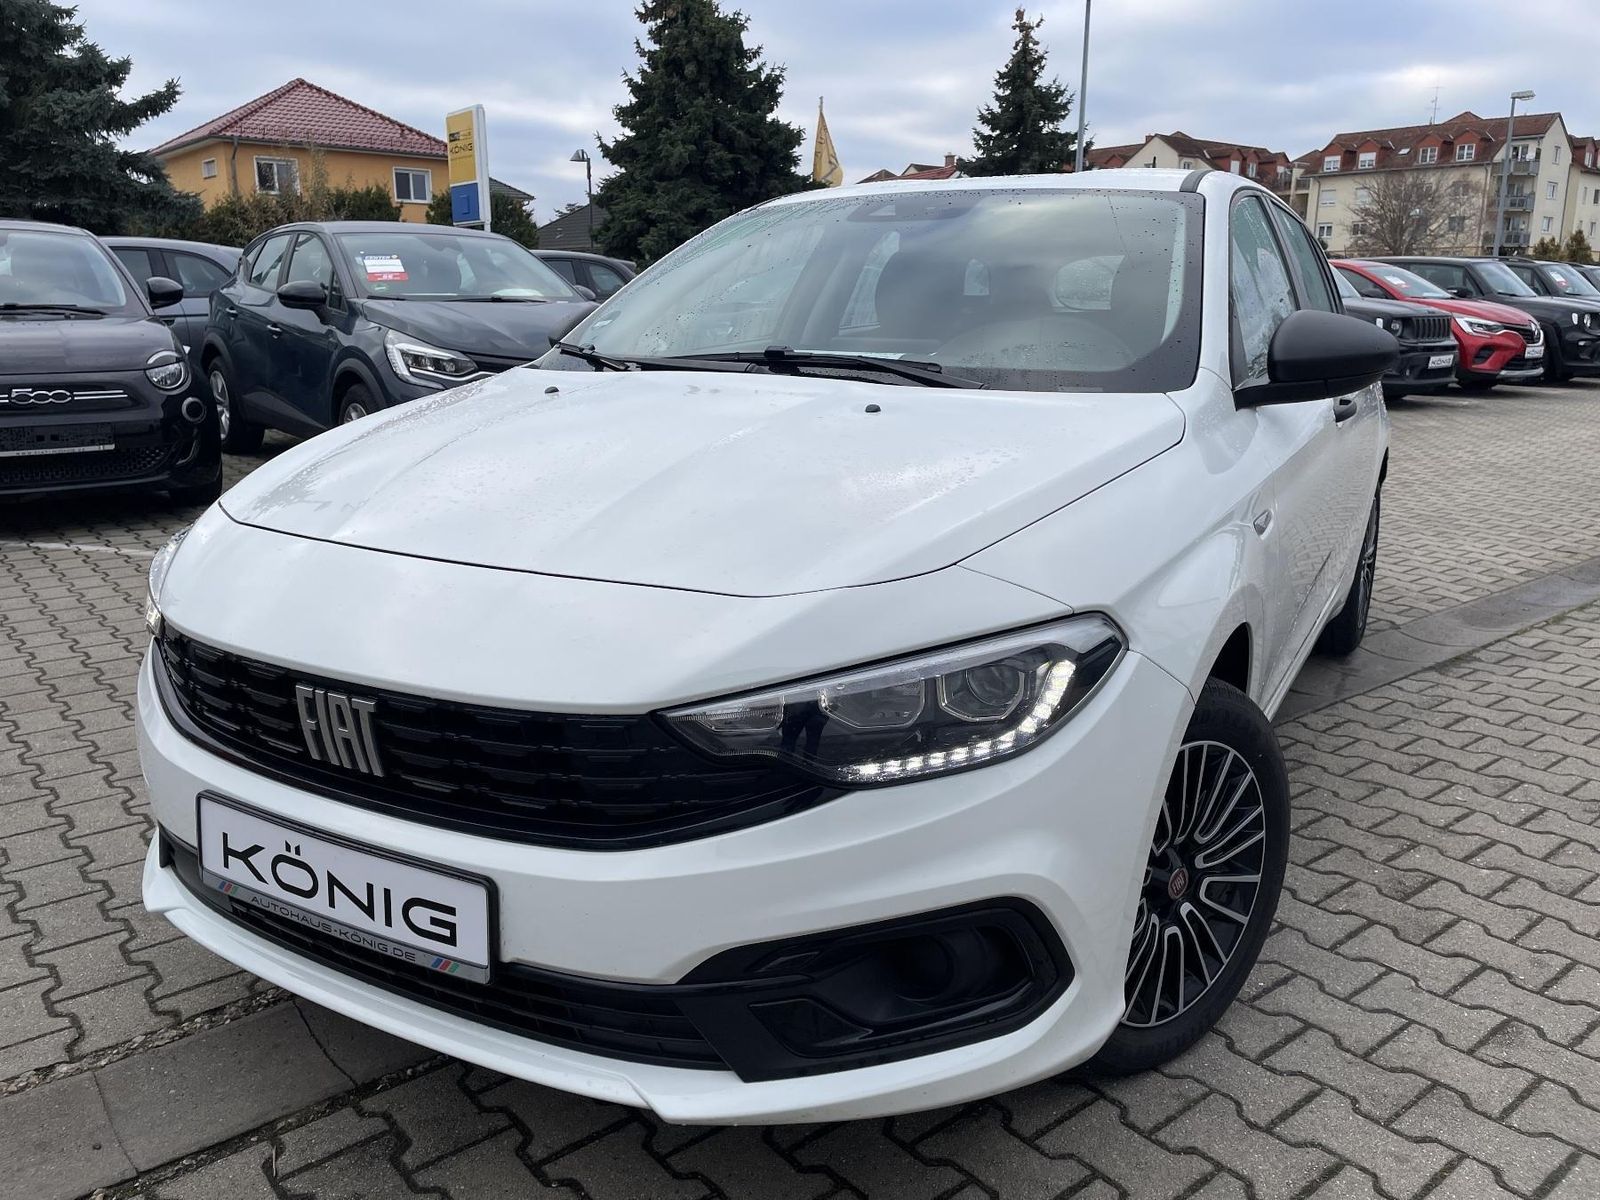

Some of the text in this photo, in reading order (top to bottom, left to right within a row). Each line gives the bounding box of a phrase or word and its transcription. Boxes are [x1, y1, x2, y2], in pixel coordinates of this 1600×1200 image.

[11, 388, 72, 405] 500
[295, 685, 385, 777] FIAT
[222, 831, 457, 947] KÖNIG
[1171, 872, 1185, 894] FIAT
[250, 895, 416, 962] AUTOHAUS-KÖNIG.DE
